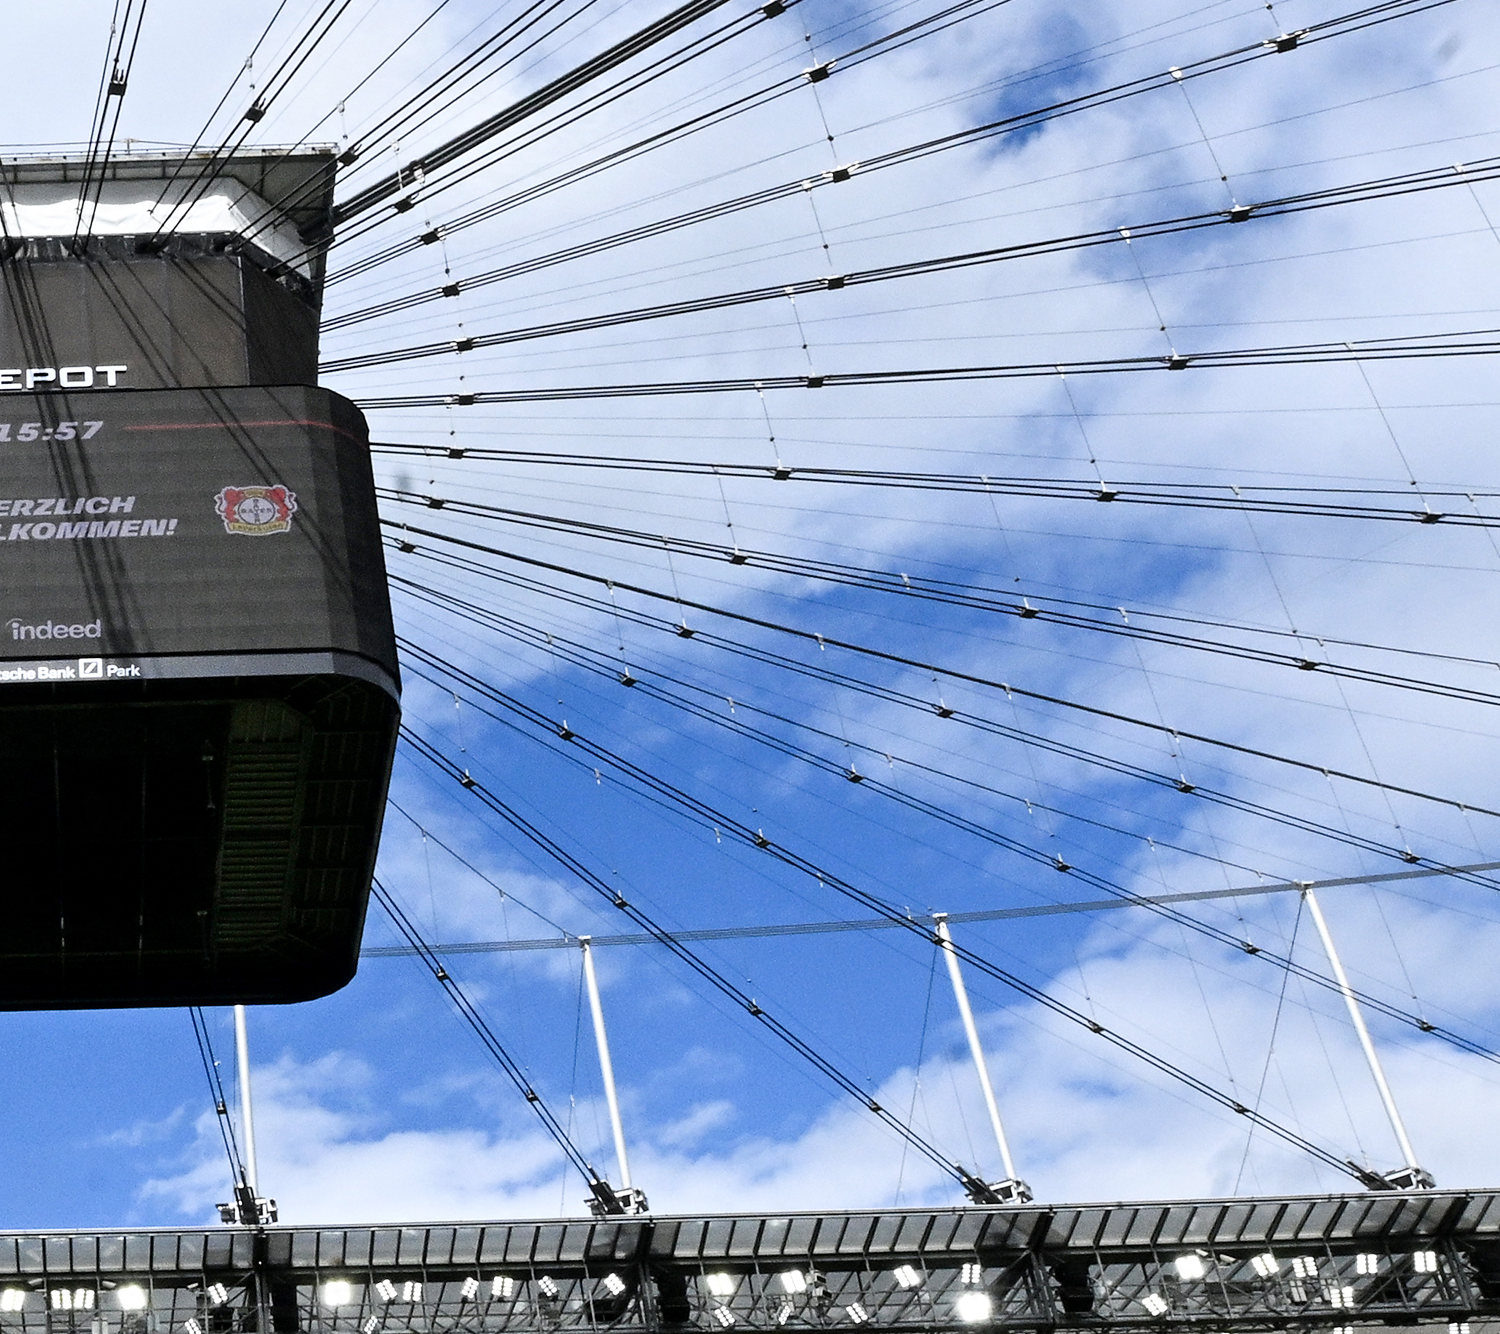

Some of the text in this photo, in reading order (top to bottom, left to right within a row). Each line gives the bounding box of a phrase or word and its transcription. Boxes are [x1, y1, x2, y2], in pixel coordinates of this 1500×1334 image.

[6, 619, 101, 640] indeed
[38, 666, 76, 679] Bank
[107, 664, 140, 677] Park
